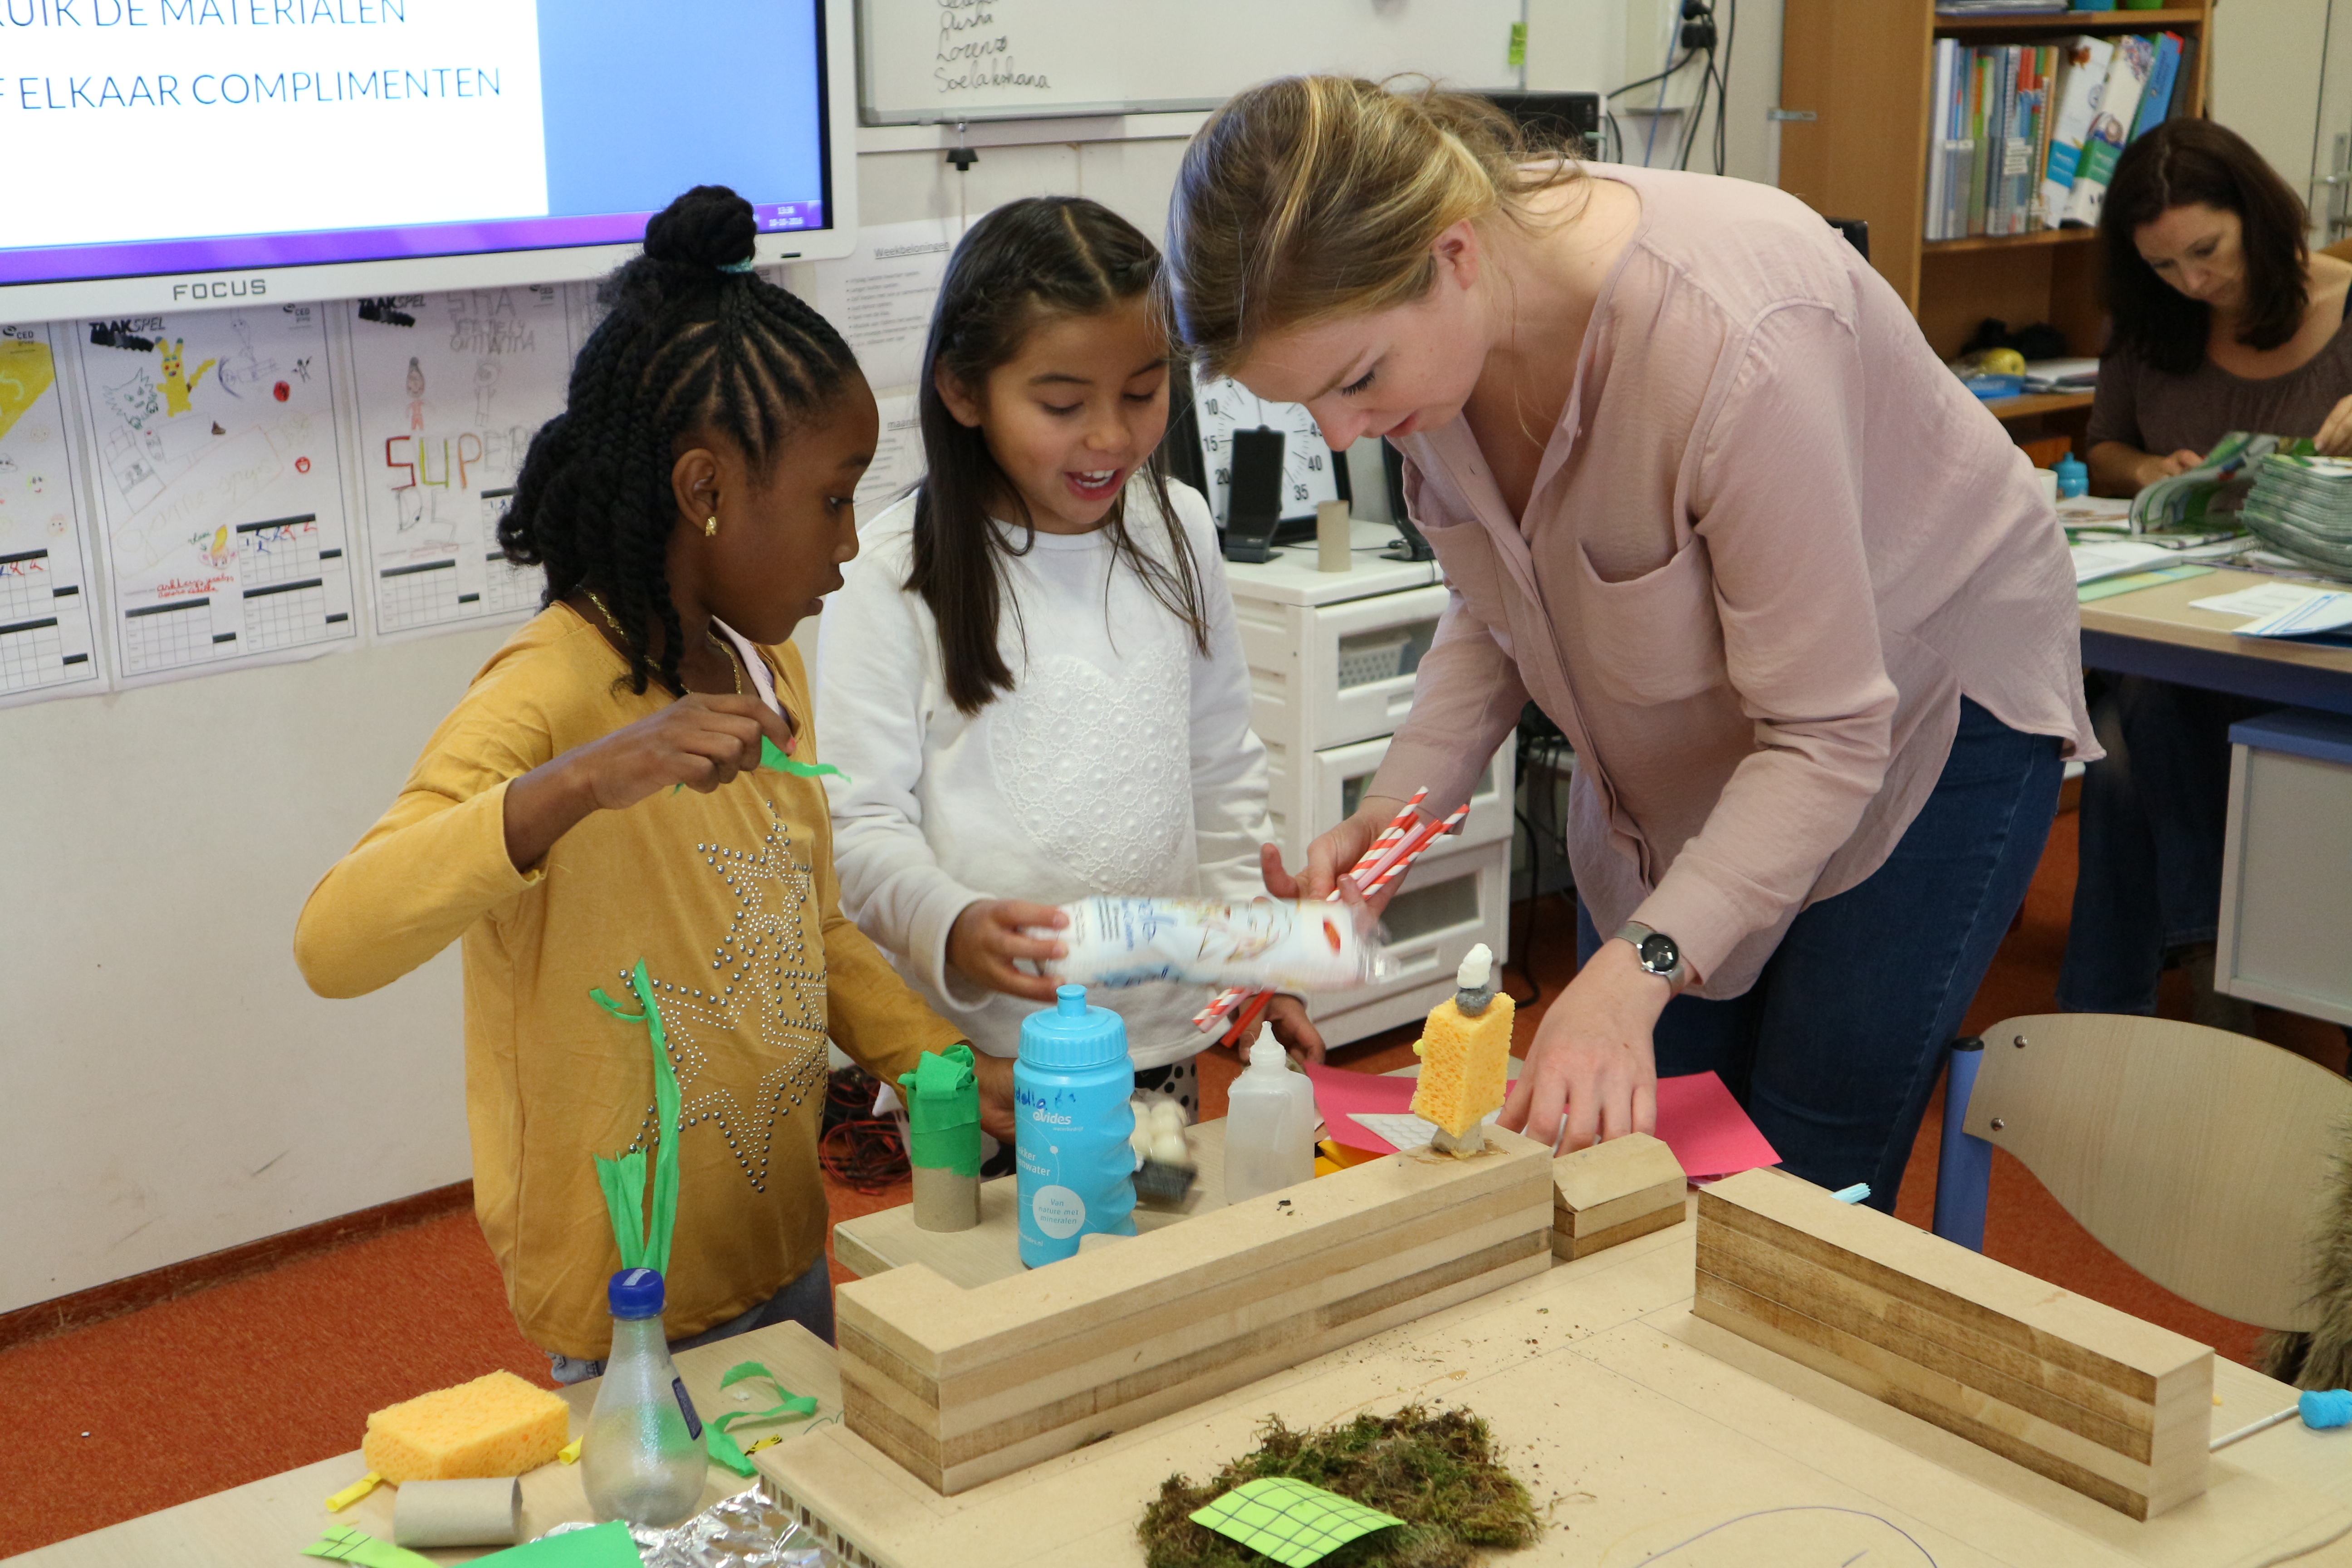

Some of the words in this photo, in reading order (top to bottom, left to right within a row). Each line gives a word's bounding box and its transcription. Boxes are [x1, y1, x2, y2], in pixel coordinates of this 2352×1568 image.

[94, 0, 147, 26] DE
[161, 0, 404, 25] MATERIALEN
[20, 75, 181, 109] ELKAAR
[193, 68, 500, 104] COMPLIMENTEN
[173, 279, 266, 300] FOCUS
[1205, 398, 1218, 415] 10
[1203, 435, 1218, 452] 15
[1308, 455, 1323, 471] 40
[1215, 468, 1230, 485] 20
[1294, 484, 1309, 500] 35
[1033, 1108, 1072, 1125] evides
[1039, 1206, 1061, 1215] nature
[1051, 1198, 1064, 1206] Van
[1040, 1215, 1077, 1224] mineralen
